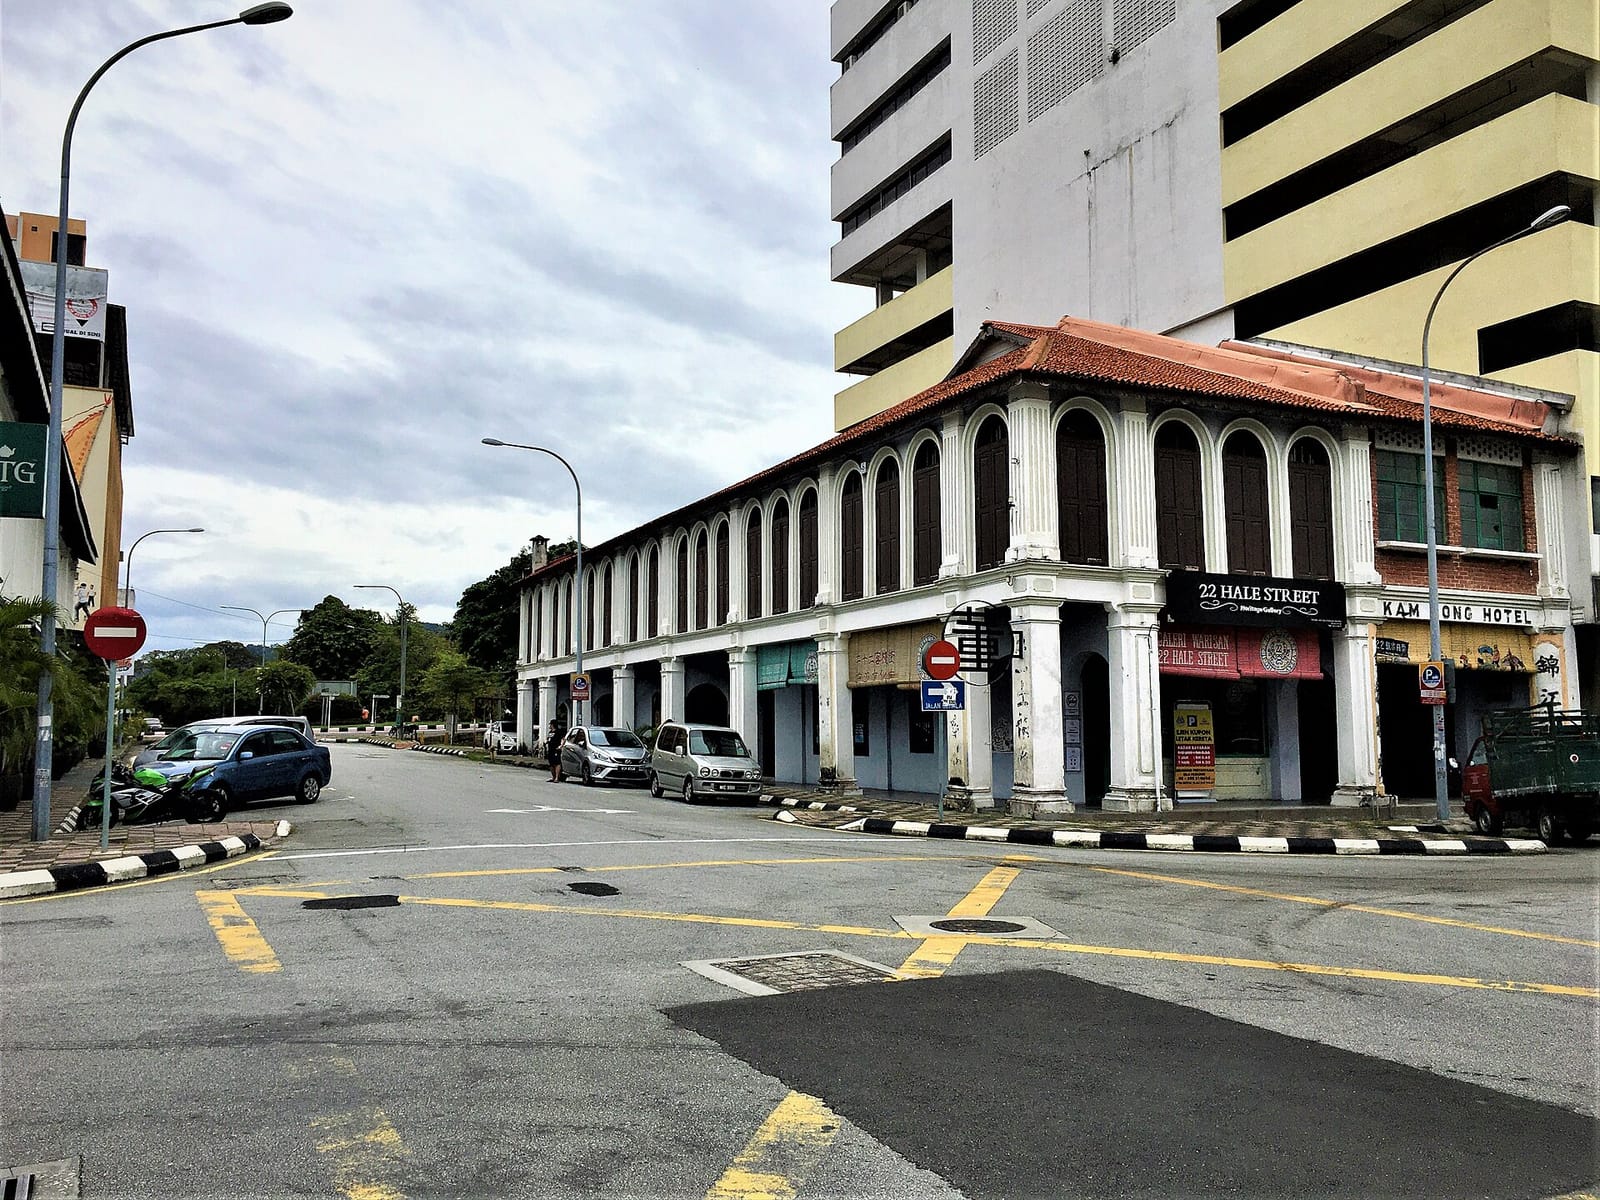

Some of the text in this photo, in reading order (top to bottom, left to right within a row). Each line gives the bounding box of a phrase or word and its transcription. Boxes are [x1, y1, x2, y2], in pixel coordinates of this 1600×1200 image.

[1199, 584, 1320, 604] 22 HALE STREET
[1383, 601, 1532, 625] KAM ONG HOTEL
[1192, 633, 1230, 650] WARISAN
[1172, 650, 1194, 665] HALE
[1197, 651, 1229, 667] STREET
[1188, 716, 1196, 726] P
